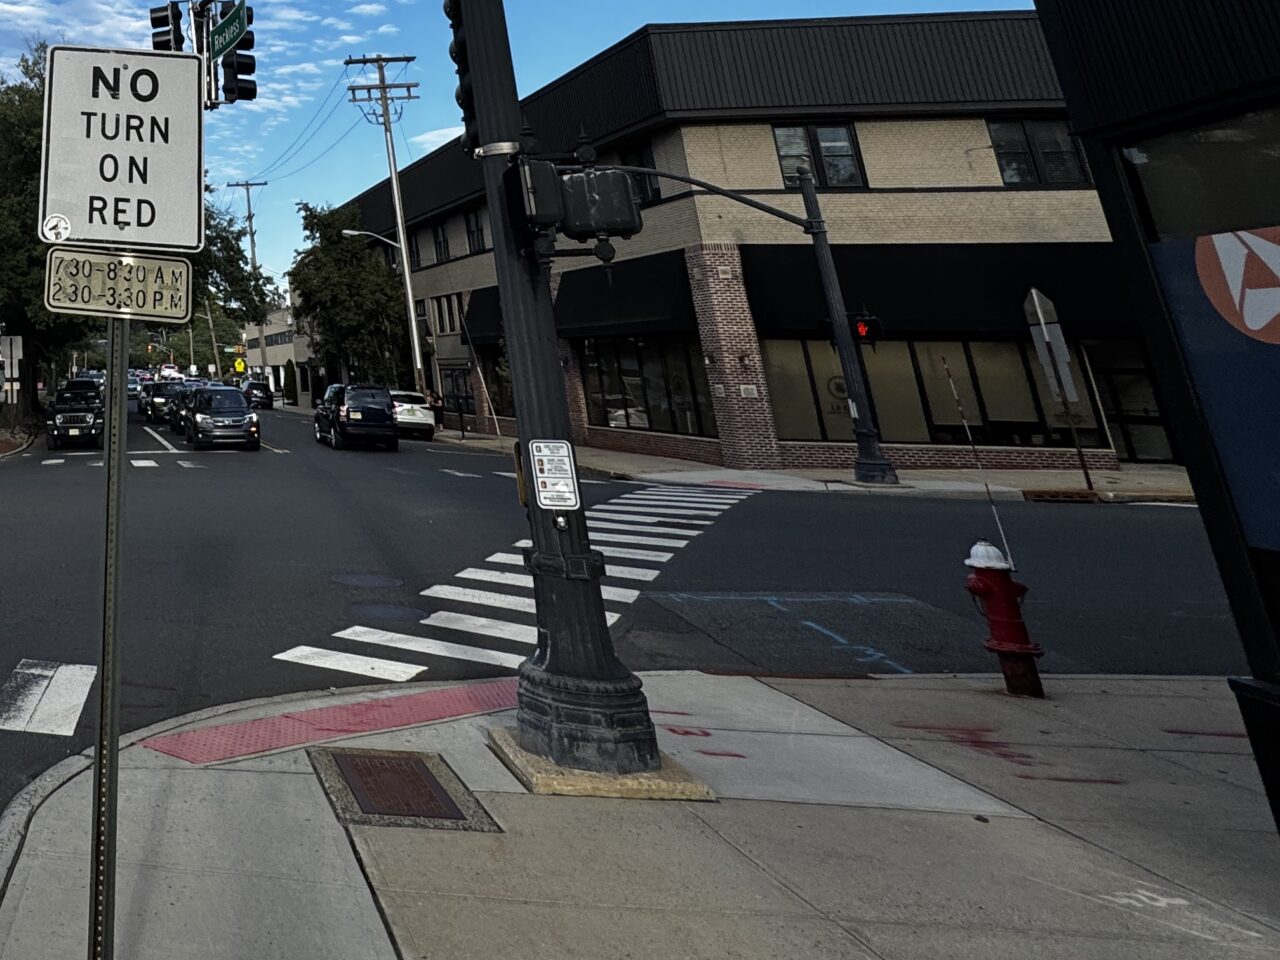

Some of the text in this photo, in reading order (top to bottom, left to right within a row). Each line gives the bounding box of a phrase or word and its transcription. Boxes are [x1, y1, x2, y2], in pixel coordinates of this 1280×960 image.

[214, 19, 240, 52] Reckless
[91, 65, 160, 103] NO
[80, 111, 170, 144] TURN
[99, 153, 149, 185] ON
[88, 195, 156, 228] RED
[55, 256, 146, 283] 730-8:30
[52, 282, 146, 309] 230-3:30
